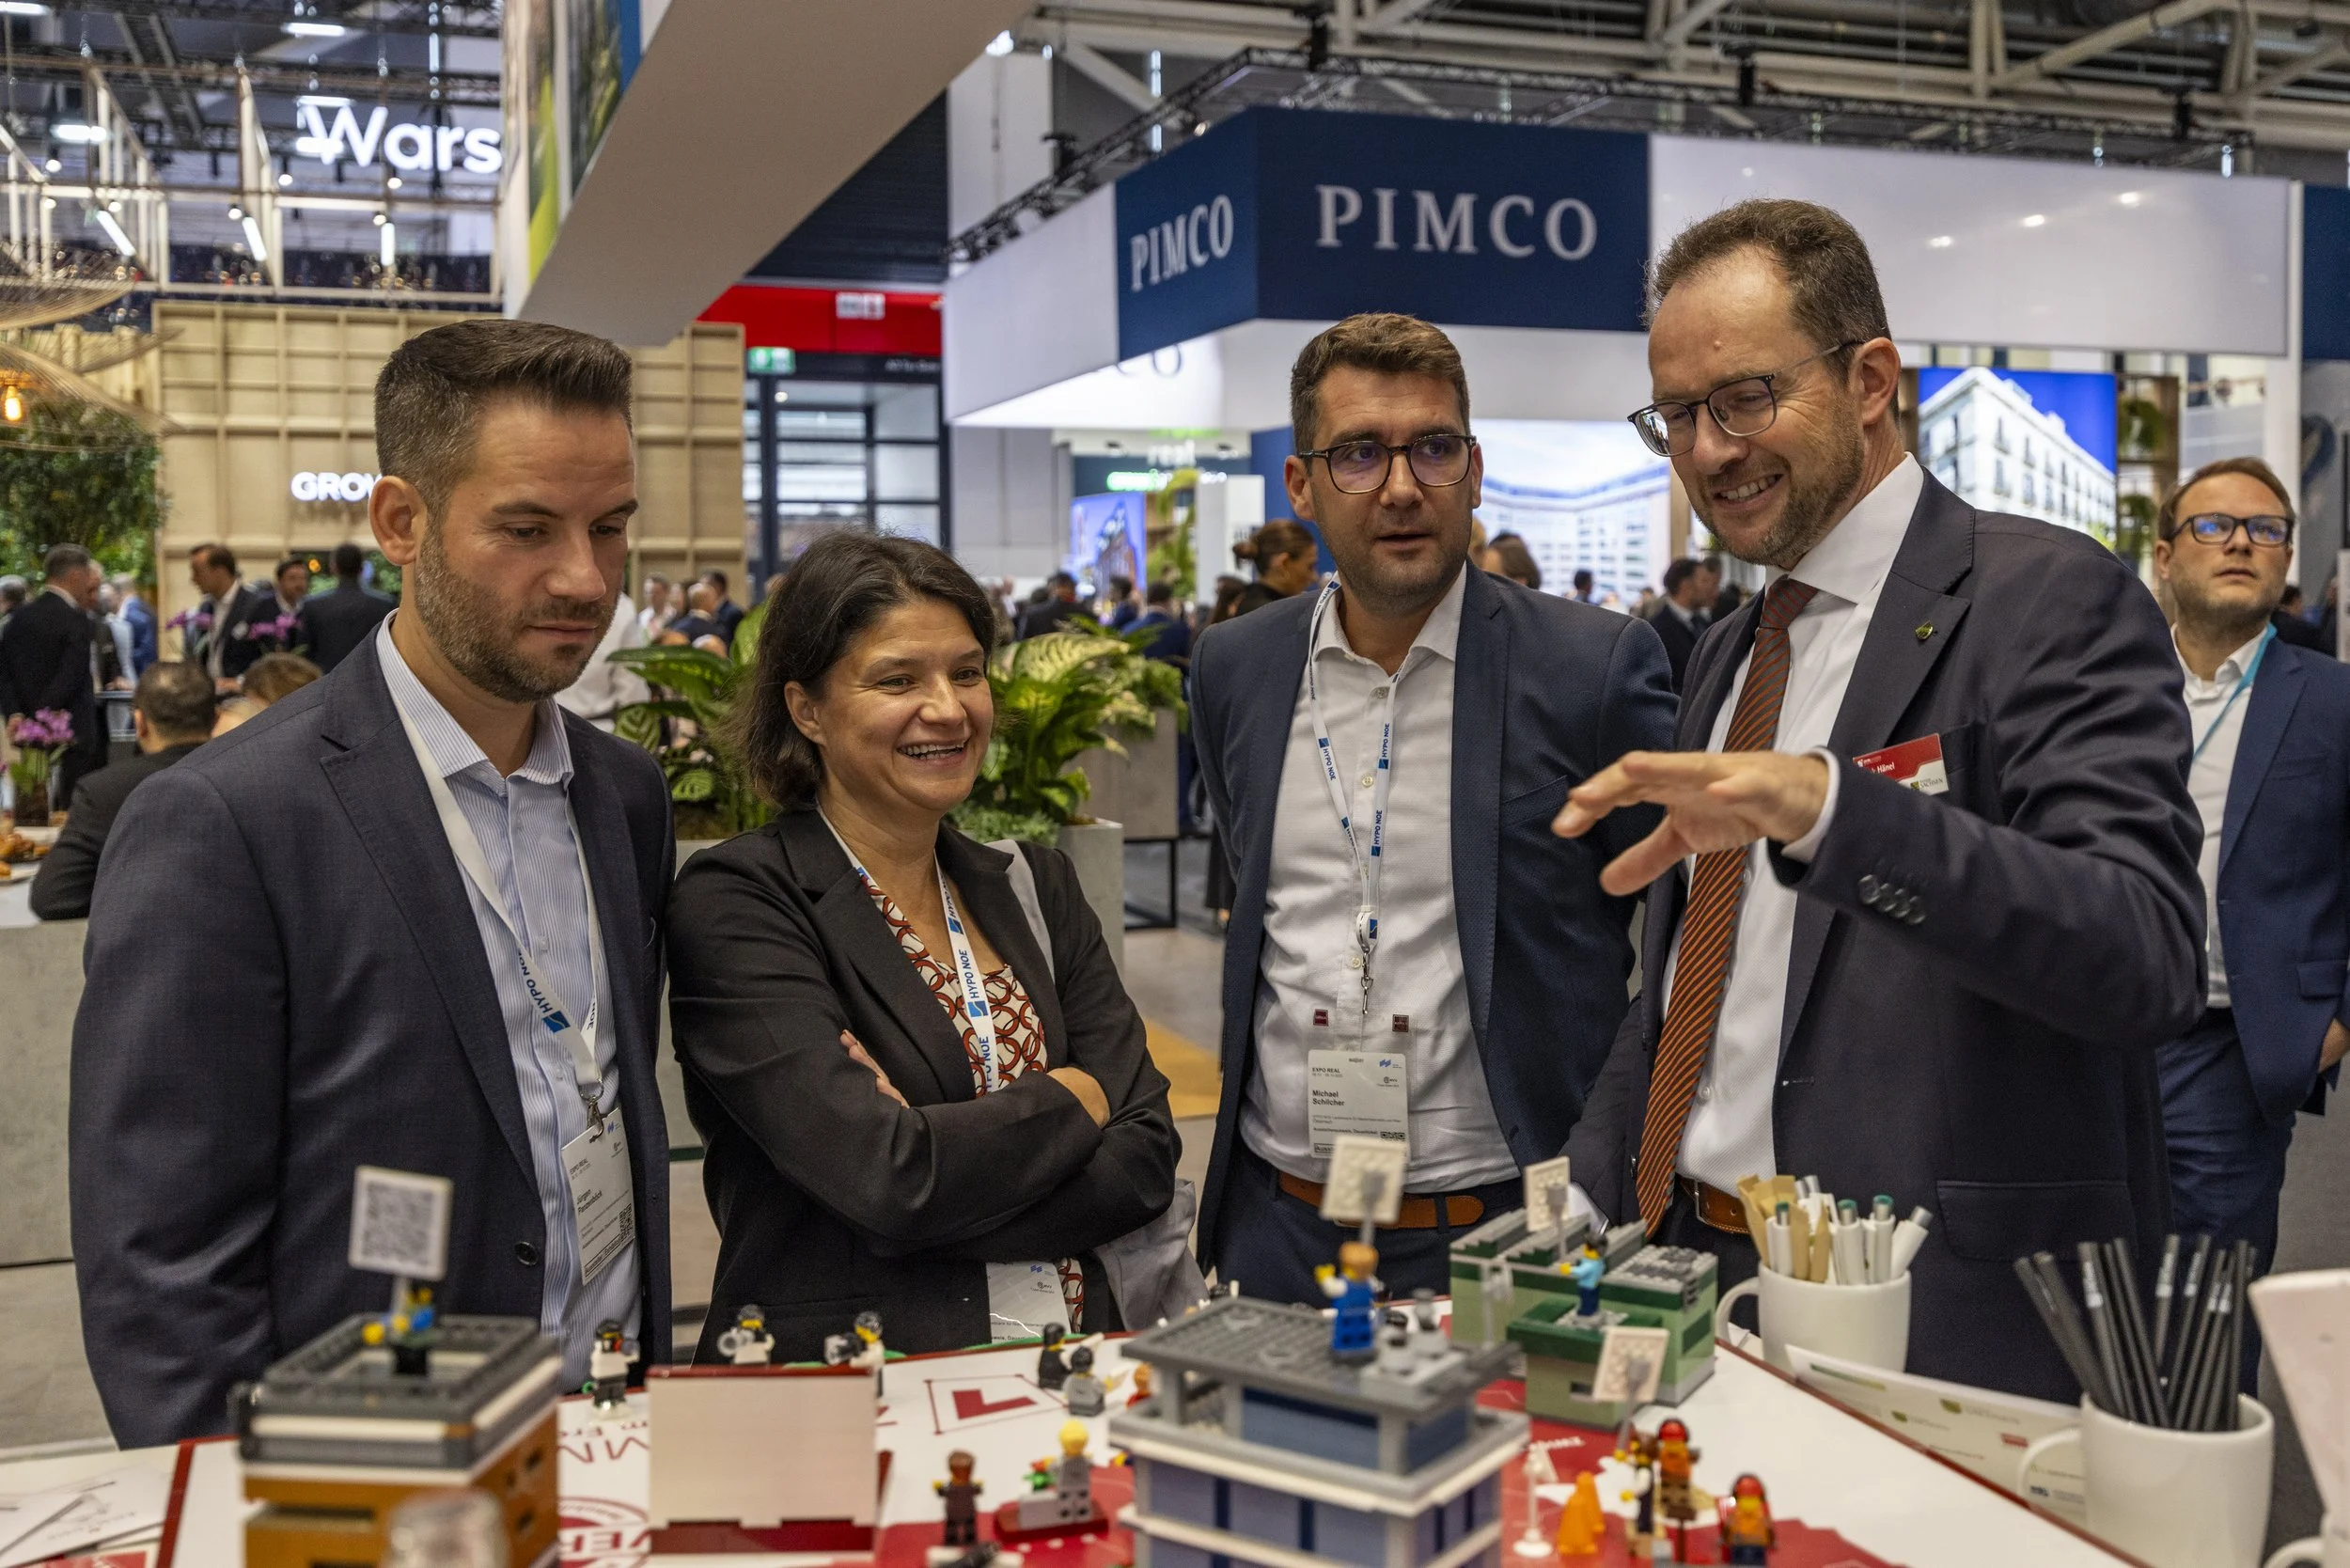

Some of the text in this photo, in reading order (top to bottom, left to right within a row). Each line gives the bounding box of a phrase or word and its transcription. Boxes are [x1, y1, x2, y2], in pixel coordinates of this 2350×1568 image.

[303, 105, 503, 174] Wars
[1316, 184, 1598, 260] PIMCO
[1130, 195, 1234, 292] PIMCO
[1323, 748, 1336, 780] HYPO NOE
[1877, 761, 1895, 774] Hänel
[959, 949, 979, 999] HYPO NOE
[526, 979, 553, 1013] HYPO
[979, 1036, 989, 1061] NOE
[1312, 1090, 1339, 1098] Michael
[1312, 1098, 1344, 1106] Schilcher
